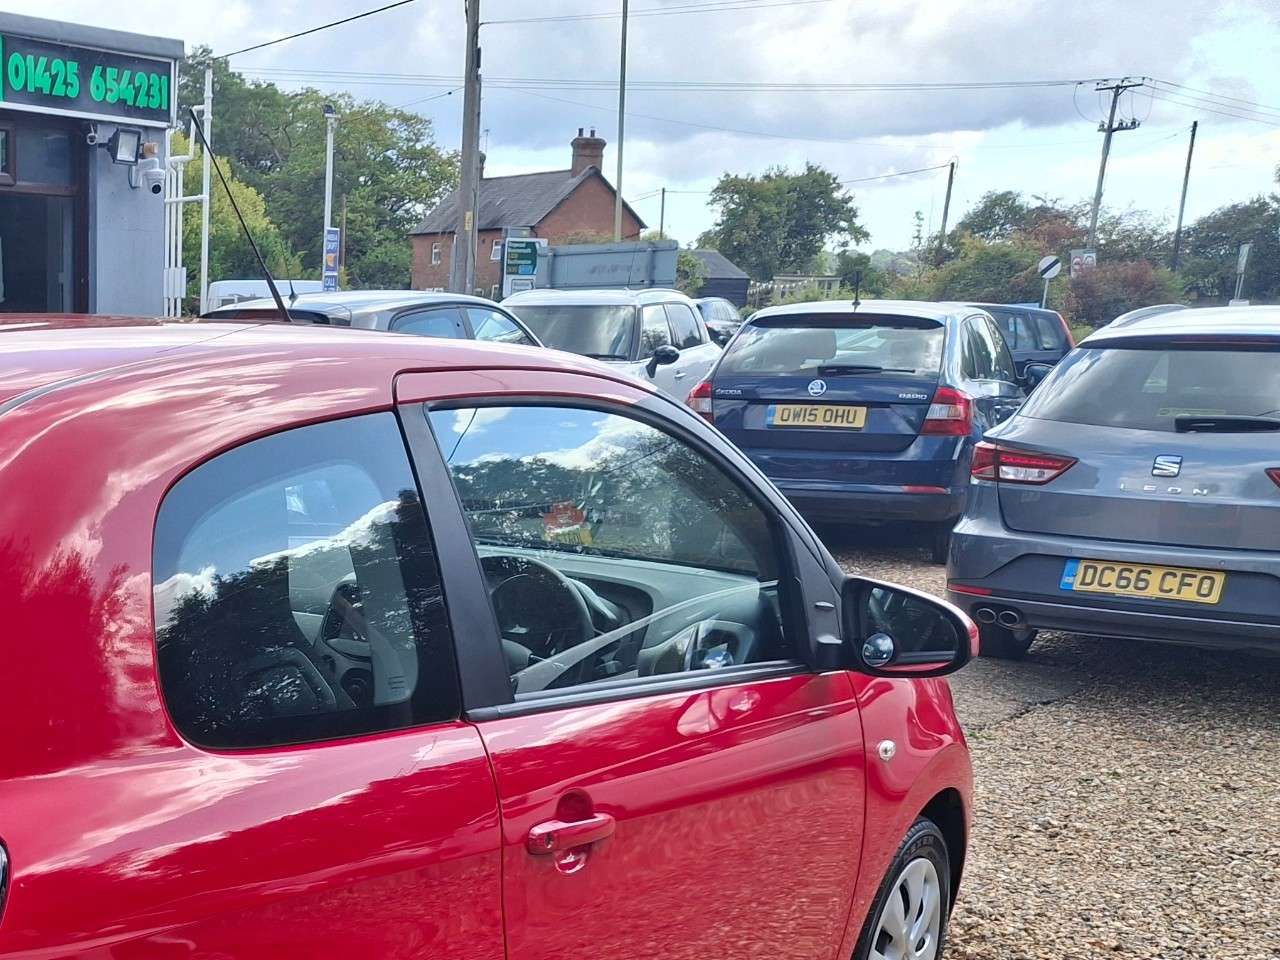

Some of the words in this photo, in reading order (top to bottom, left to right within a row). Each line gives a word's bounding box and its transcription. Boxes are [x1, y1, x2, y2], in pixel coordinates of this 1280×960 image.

[7, 51, 81, 99] 01425
[89, 64, 169, 111] 654231
[780, 406, 819, 423] OW15
[822, 408, 858, 424] OHU
[1120, 483, 1208, 497] LEON
[1079, 564, 1153, 592] DC66
[1158, 571, 1216, 598] CFO
